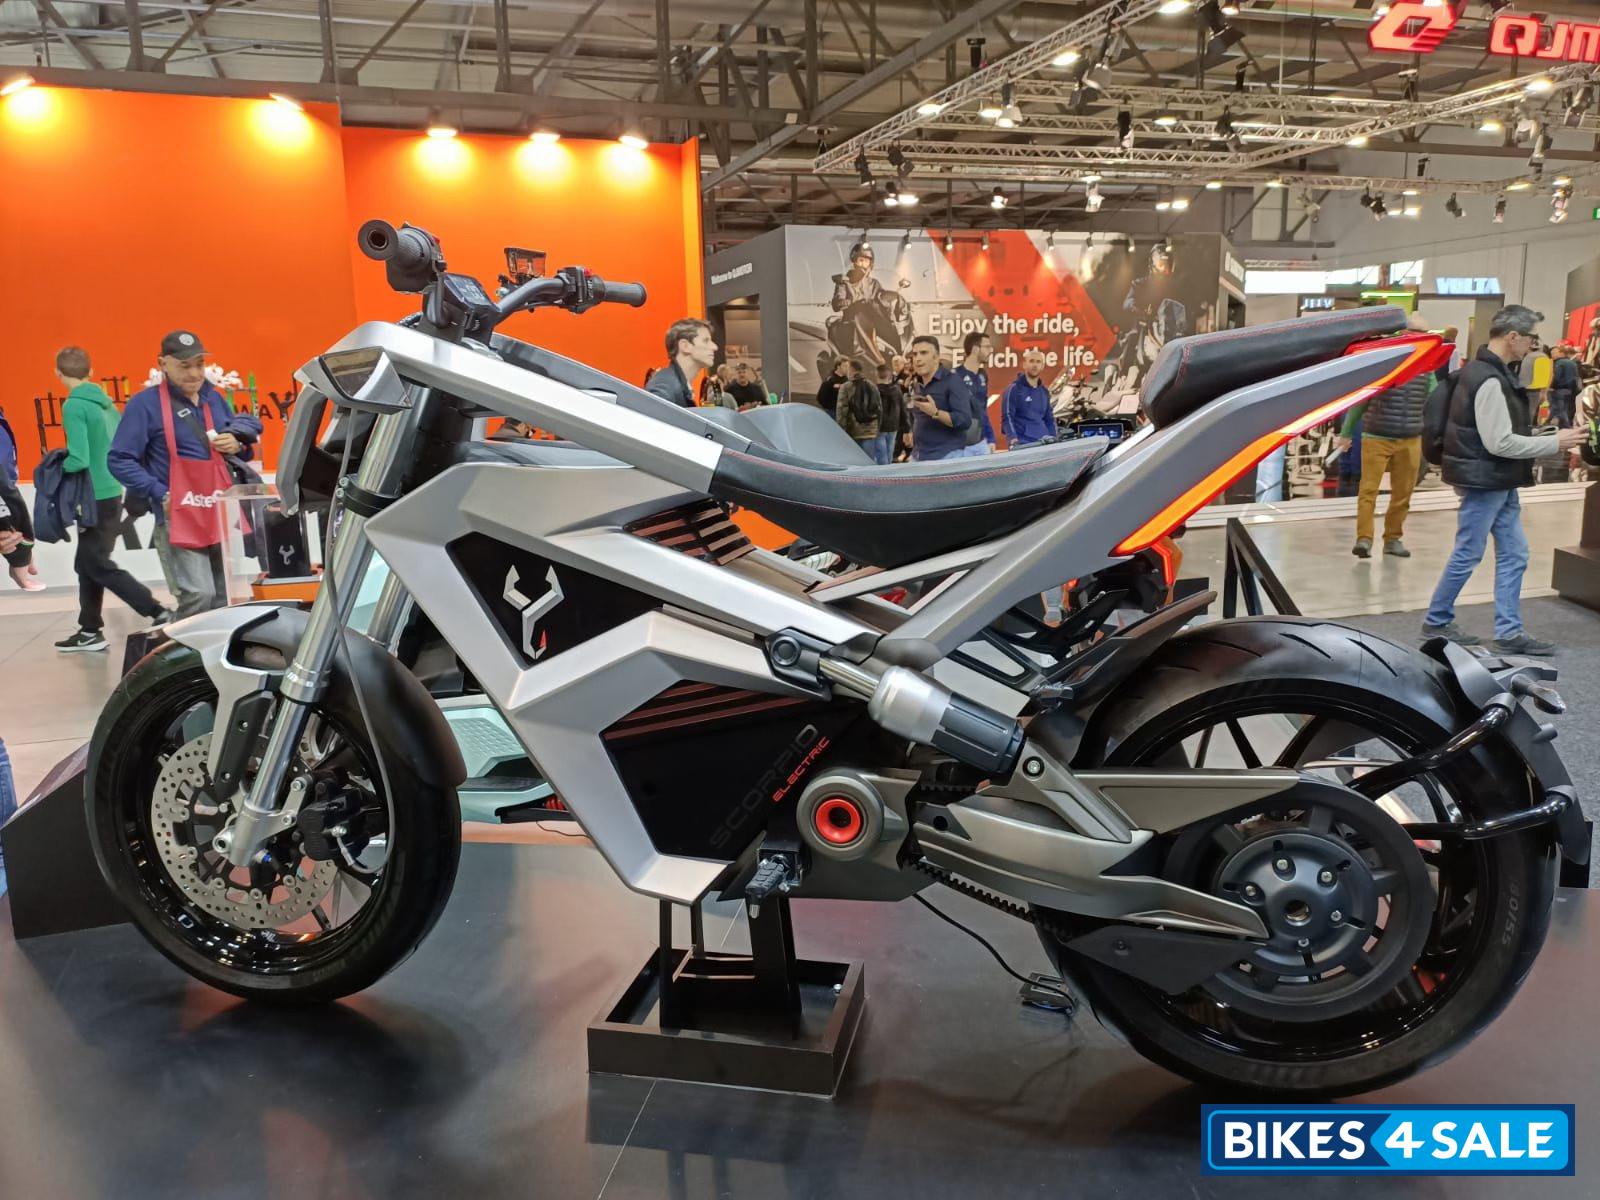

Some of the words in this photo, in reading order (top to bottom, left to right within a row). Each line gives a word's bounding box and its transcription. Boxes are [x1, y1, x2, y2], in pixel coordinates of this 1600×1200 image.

[929, 314, 987, 341] Enjoy
[993, 312, 1028, 335] the
[1033, 312, 1080, 336] ride,
[952, 347, 1018, 368] Eich
[1063, 345, 1099, 367] life.
[710, 724, 818, 849] SCORPIO
[772, 736, 830, 802] ELECTRIC
